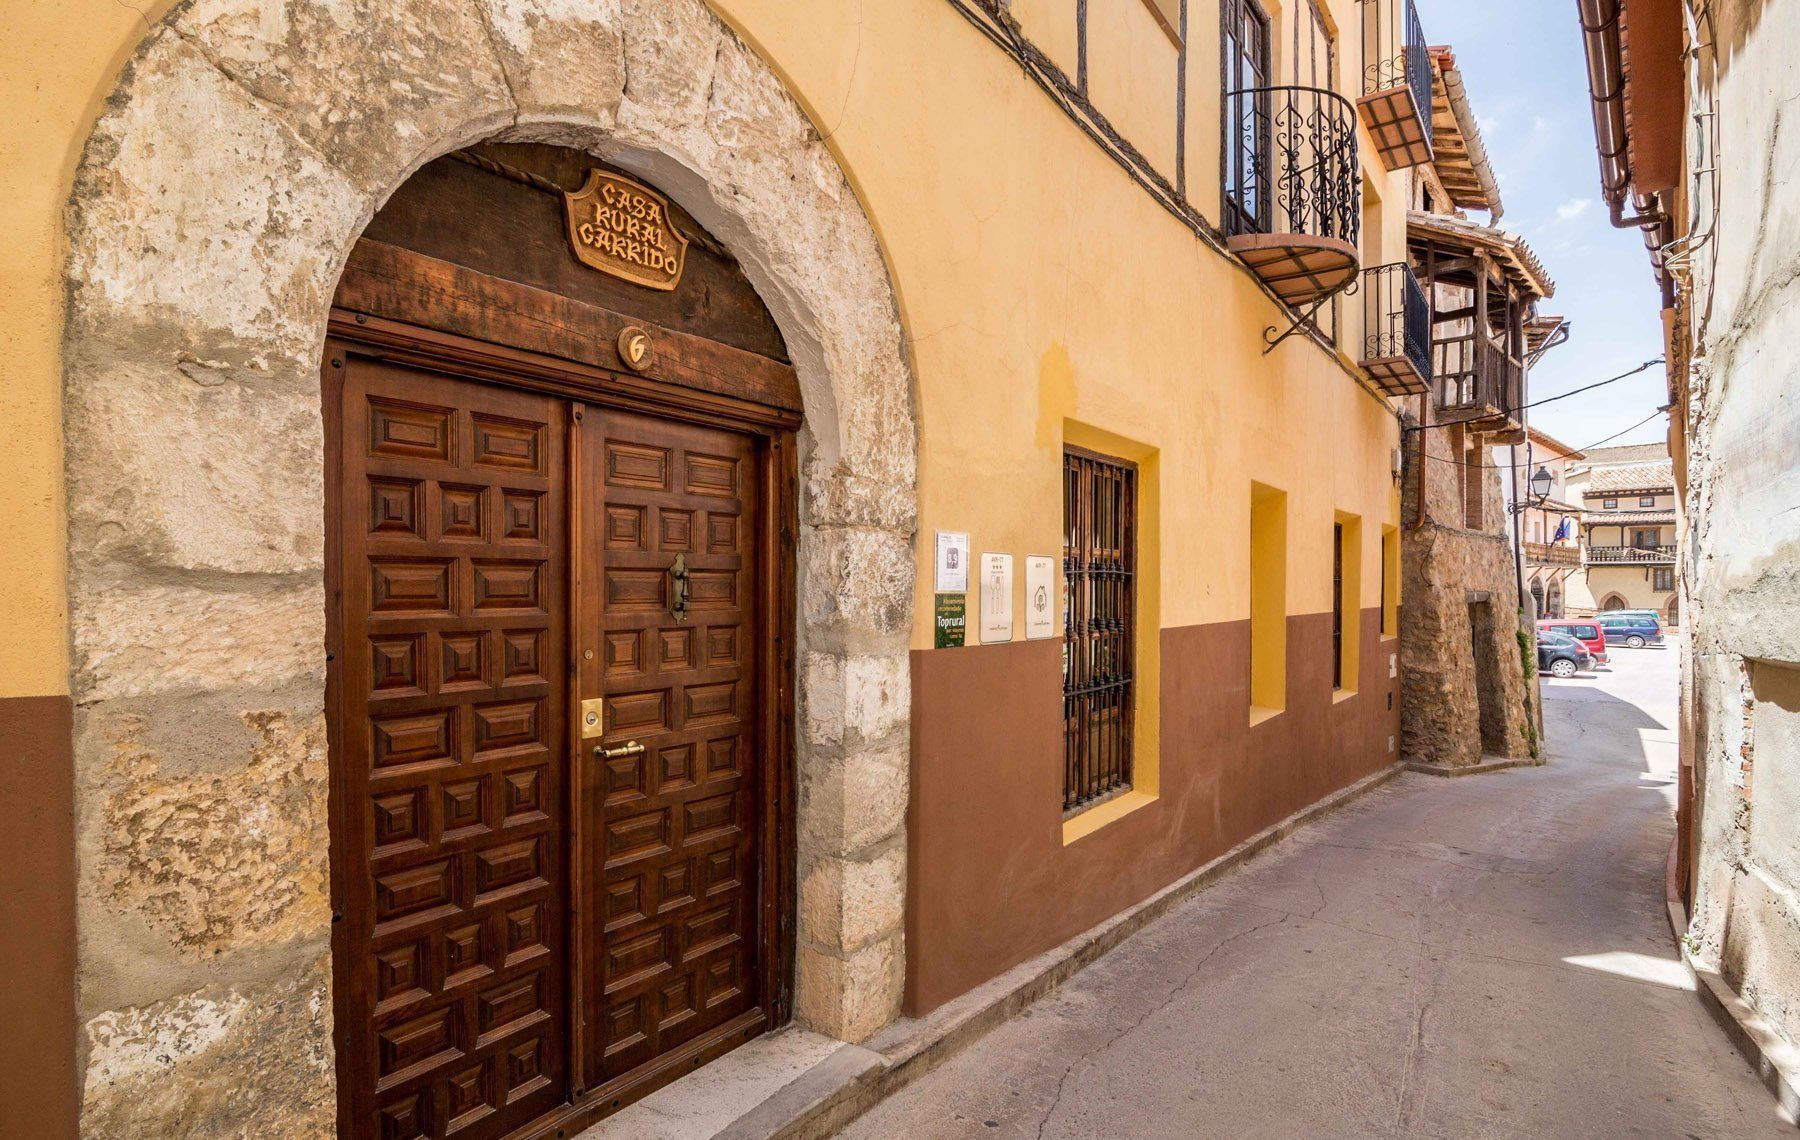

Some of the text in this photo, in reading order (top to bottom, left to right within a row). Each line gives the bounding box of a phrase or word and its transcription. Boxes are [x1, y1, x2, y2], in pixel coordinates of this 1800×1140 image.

[602, 183, 661, 224] CASA
[595, 203, 667, 251] RURAL
[630, 335, 645, 362] 6
[937, 615, 965, 629] Toprural
